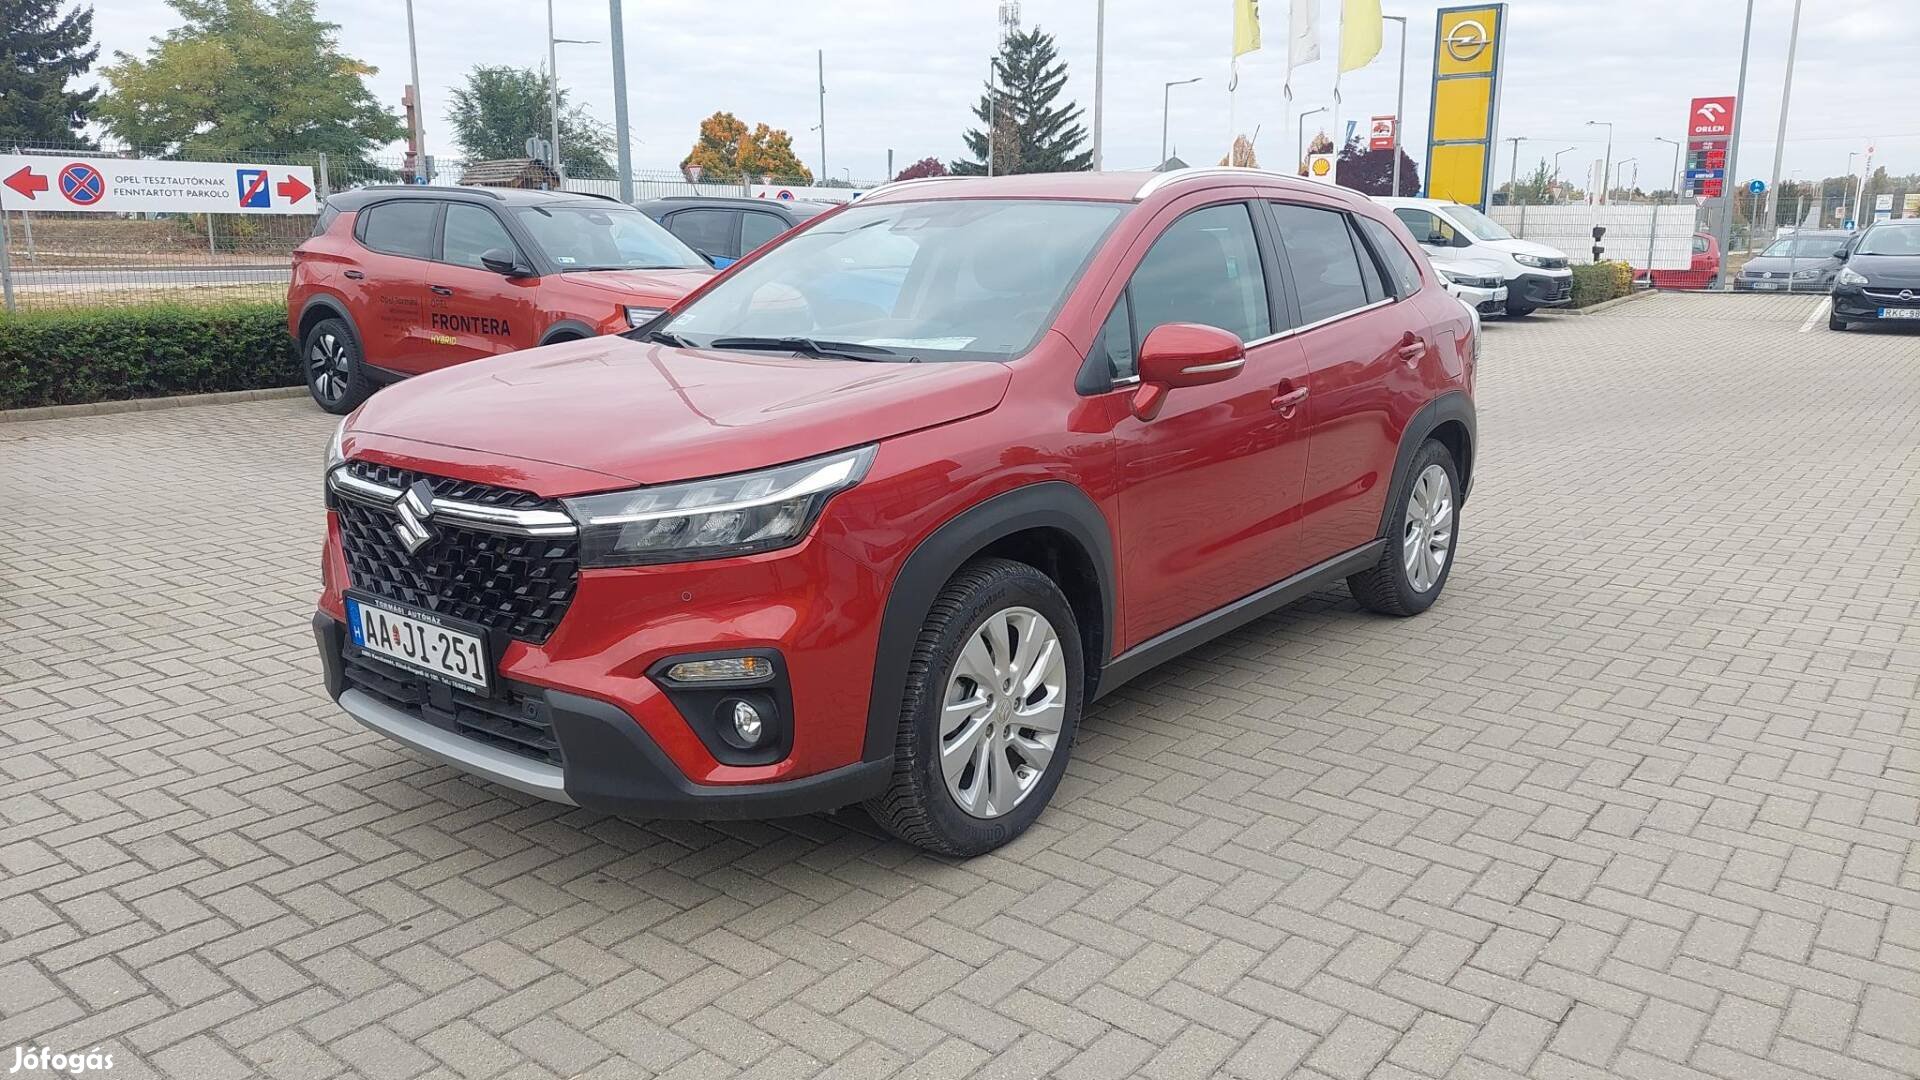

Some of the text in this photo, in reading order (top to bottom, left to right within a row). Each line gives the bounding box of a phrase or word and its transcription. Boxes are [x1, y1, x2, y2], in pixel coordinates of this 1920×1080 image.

[1695, 125, 1725, 133] ORLEN
[115, 175, 225, 186] OPEL TESZTAUTÓKNAK
[113, 187, 184, 198] FENNTARTOTT
[431, 312, 511, 337] FRONTERA
[430, 334, 457, 346] HYBRID
[354, 626, 361, 639] H
